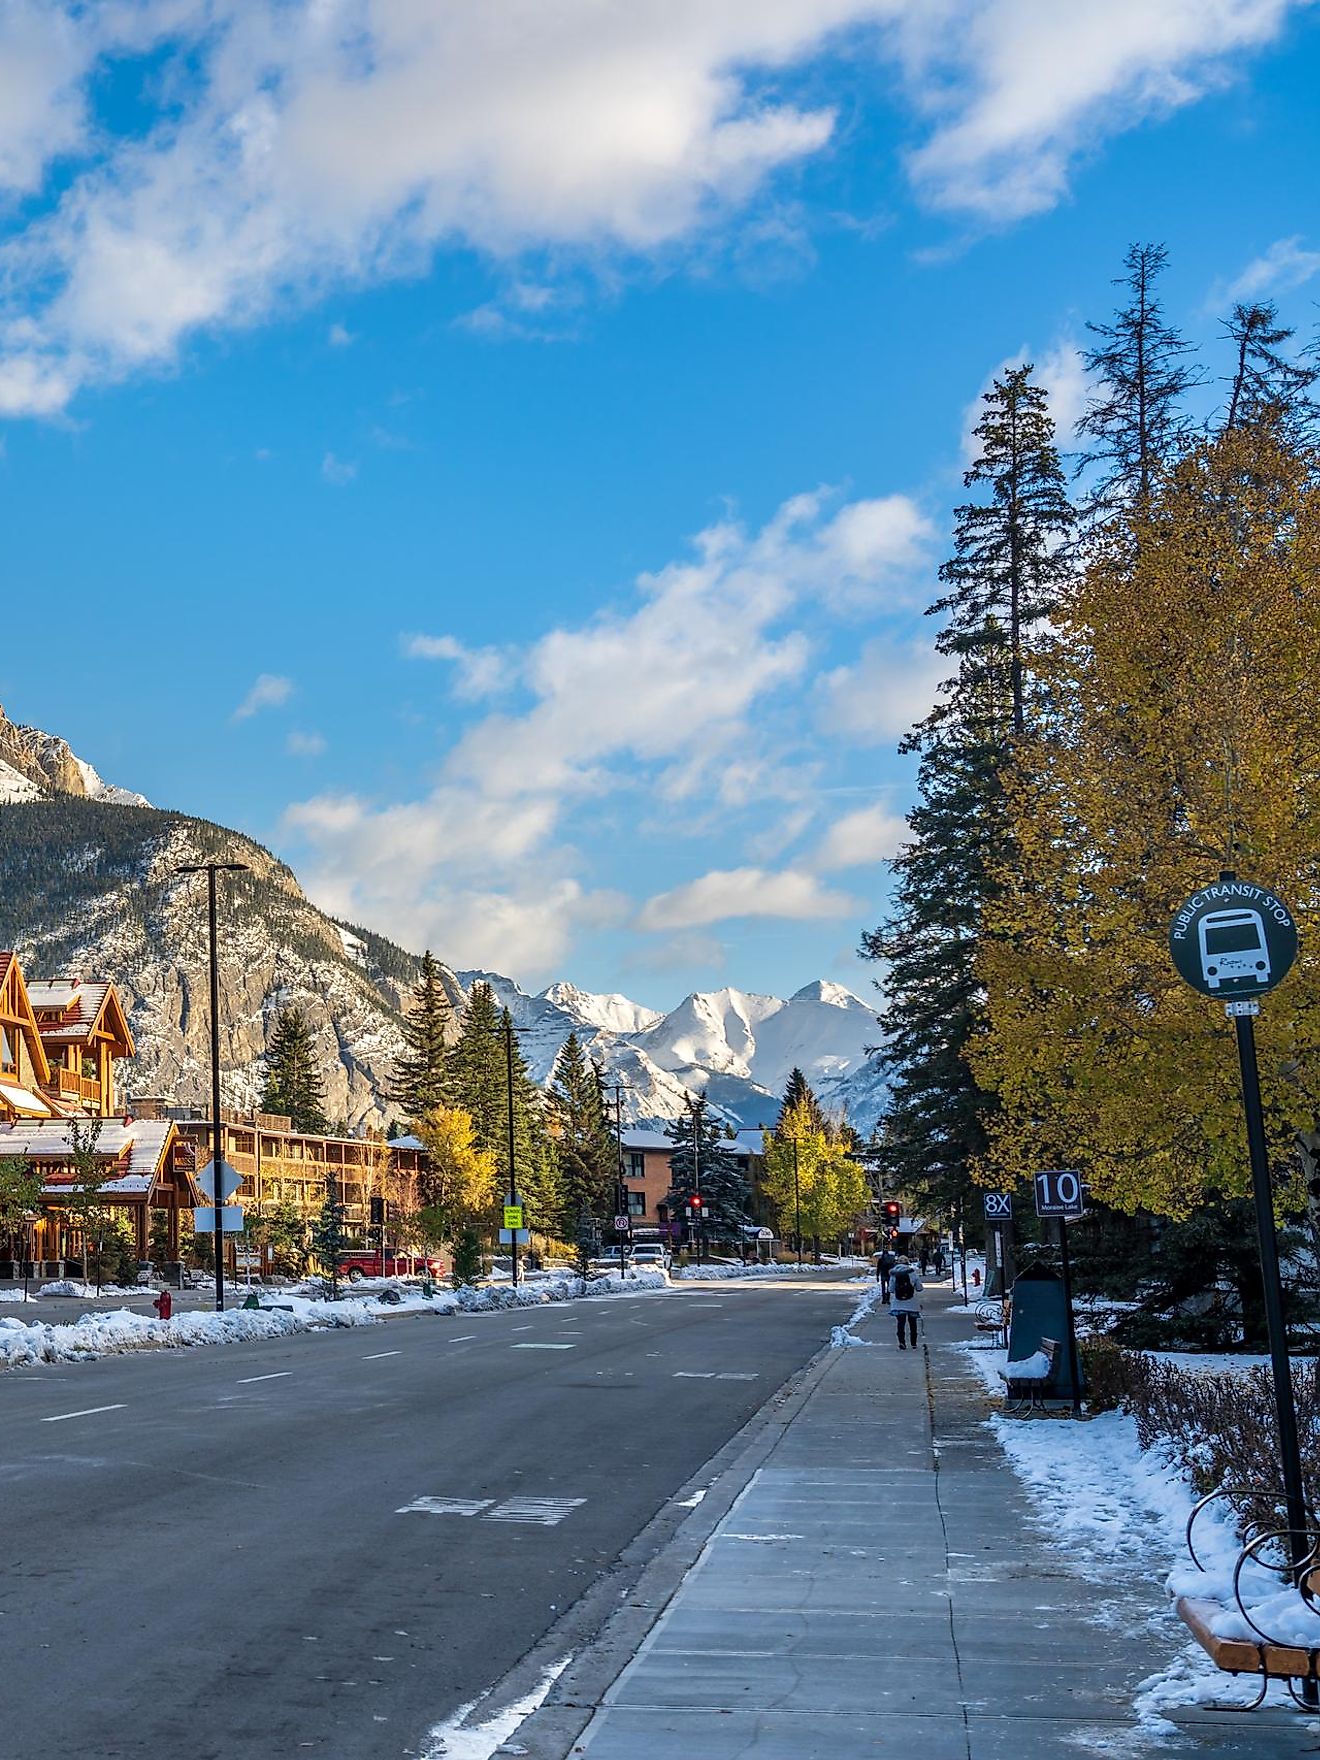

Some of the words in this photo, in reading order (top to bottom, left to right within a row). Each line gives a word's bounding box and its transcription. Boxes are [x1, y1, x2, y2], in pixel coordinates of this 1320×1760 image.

[1174, 897, 1203, 940] PUBLIC
[1201, 884, 1264, 901] TRANSIT
[1262, 896, 1291, 927] STOP
[1037, 1173, 1078, 1203] 10
[986, 1195, 1010, 1213] 8X
